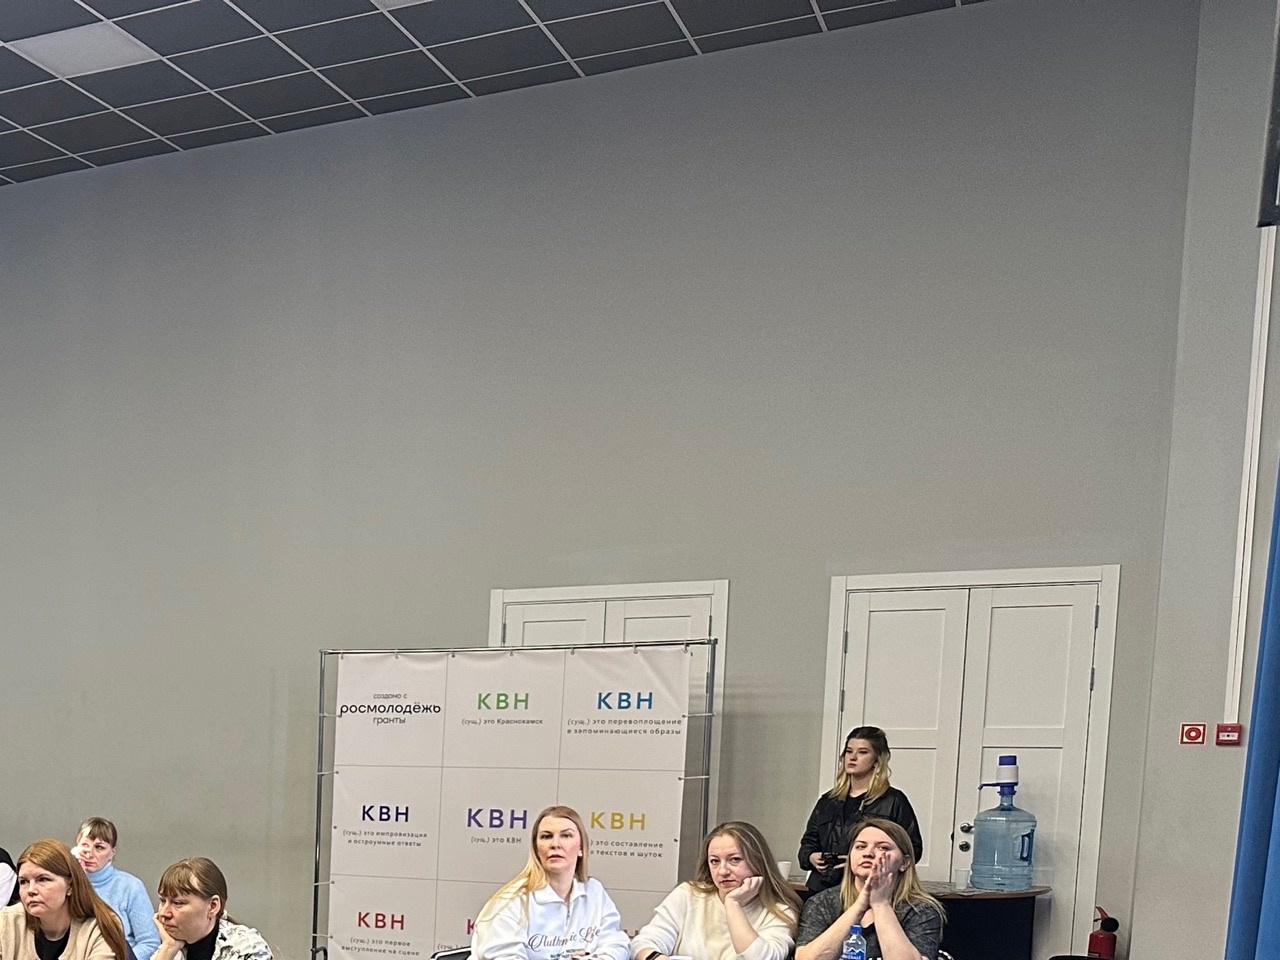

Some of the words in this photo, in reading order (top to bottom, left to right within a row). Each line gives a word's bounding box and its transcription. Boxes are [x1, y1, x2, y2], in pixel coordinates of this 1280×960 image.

[340, 701, 441, 718] росмолодёжь
[477, 693, 529, 710] КВН
[597, 692, 653, 710] КВН
[373, 716, 406, 726] гранты
[496, 718, 543, 726] Краснокамск
[649, 727, 681, 736] образы
[361, 805, 409, 823] КВН
[467, 808, 527, 829] КВН
[590, 811, 646, 831] КВН
[376, 831, 428, 839] импровизация
[637, 851, 663, 859] шуток
[357, 911, 405, 931] КВН
